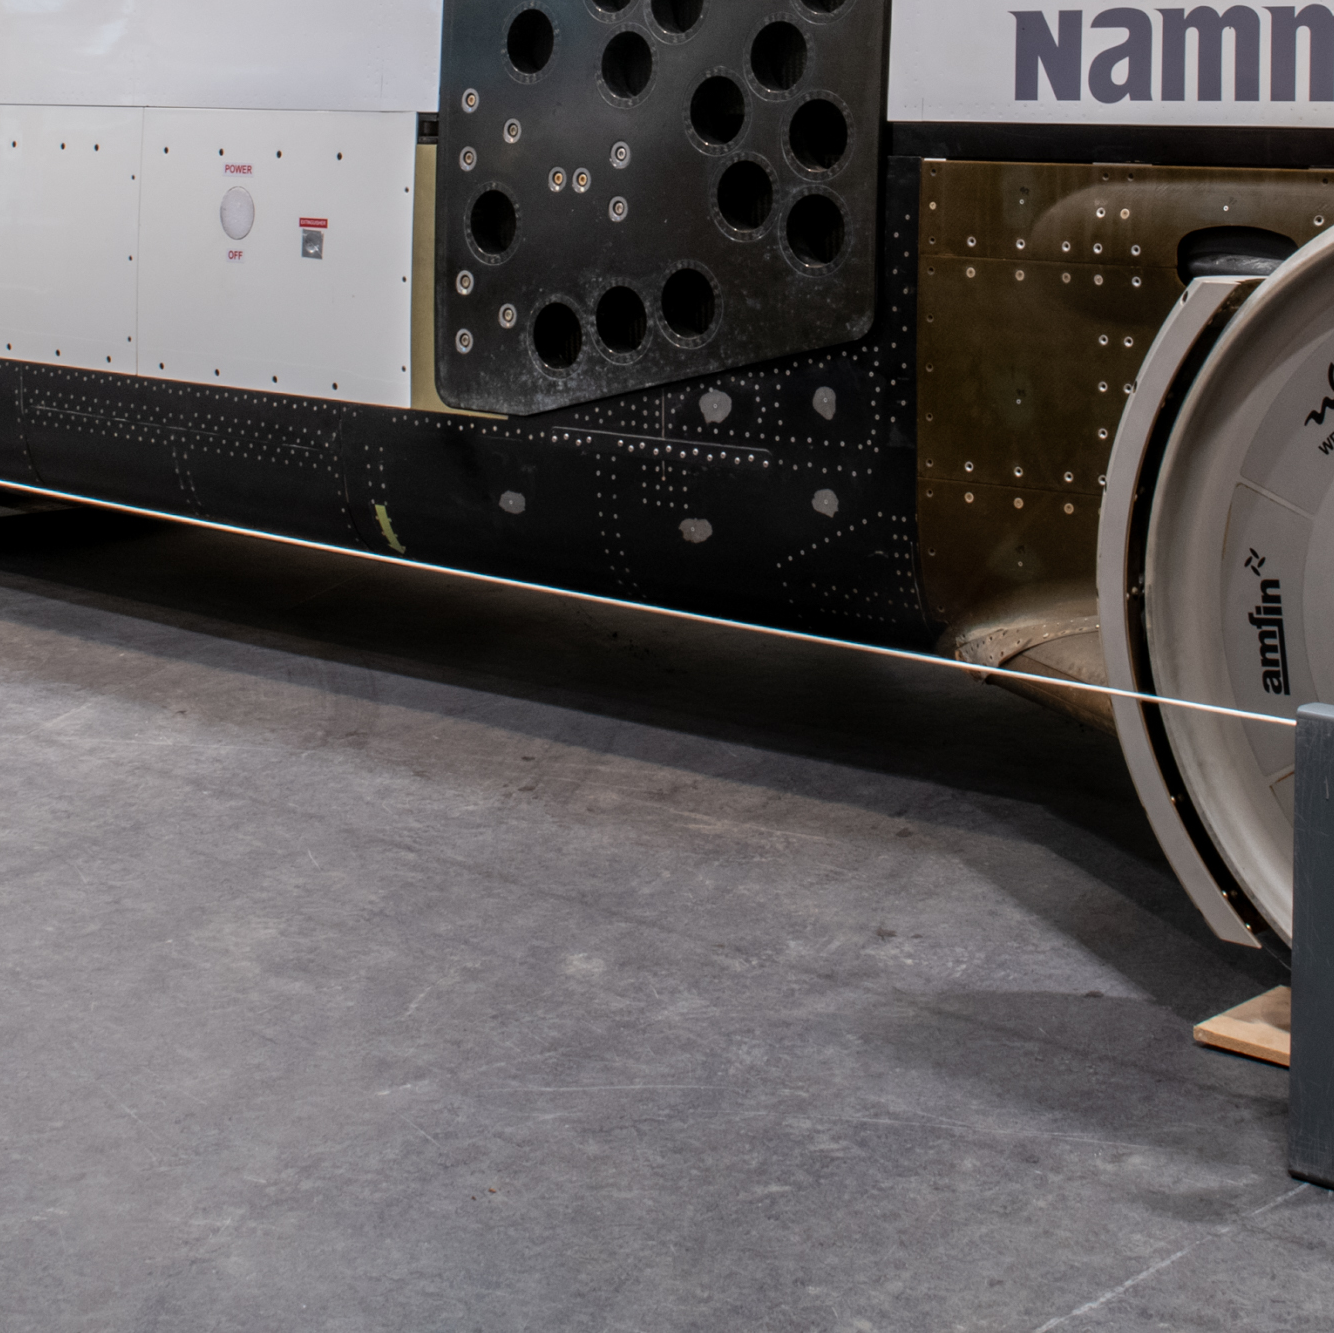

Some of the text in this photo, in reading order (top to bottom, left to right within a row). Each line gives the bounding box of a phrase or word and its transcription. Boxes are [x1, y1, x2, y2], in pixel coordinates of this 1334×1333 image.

[224, 164, 253, 175] POWER
[227, 250, 244, 260] OFF
[1248, 578, 1291, 696] amfin
